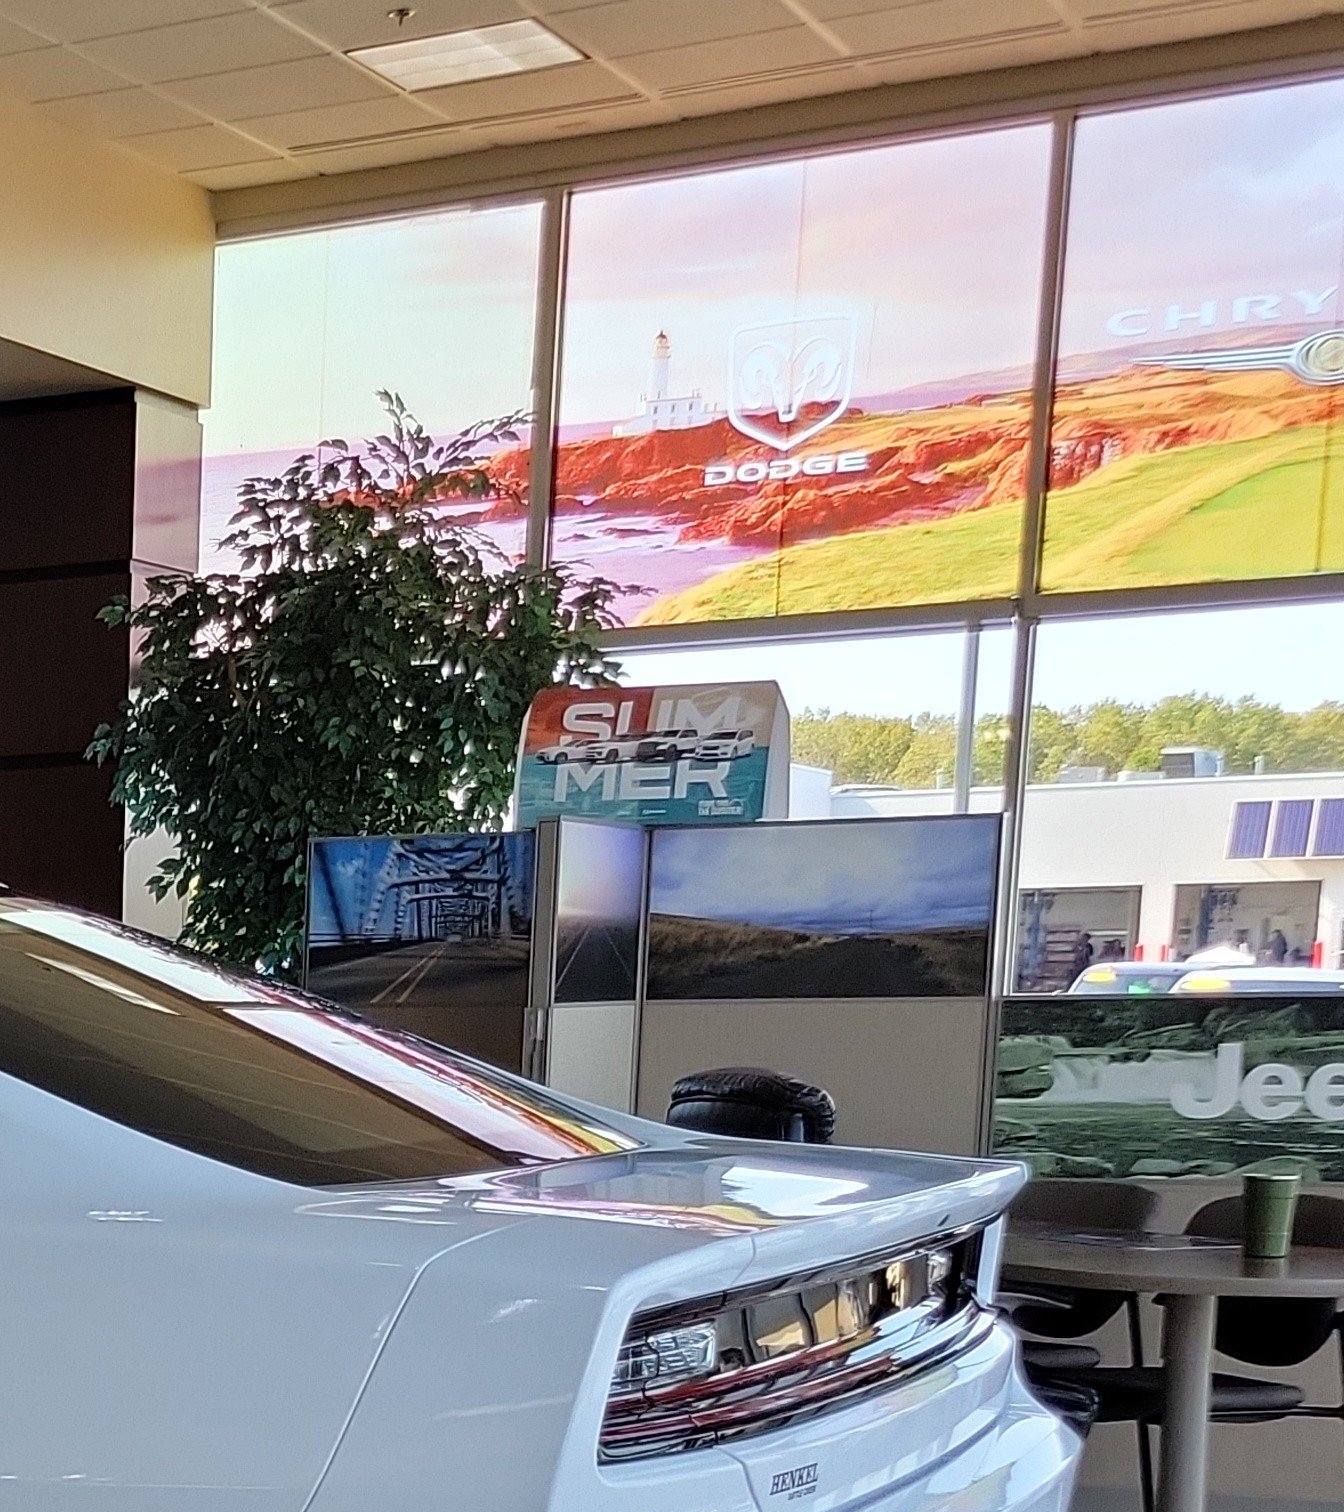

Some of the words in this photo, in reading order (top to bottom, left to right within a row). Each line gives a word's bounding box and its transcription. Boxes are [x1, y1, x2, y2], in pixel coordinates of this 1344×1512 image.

[703, 452, 868, 486] DODGE
[553, 760, 729, 802] MER
[769, 1462, 819, 1495] HENKEL
